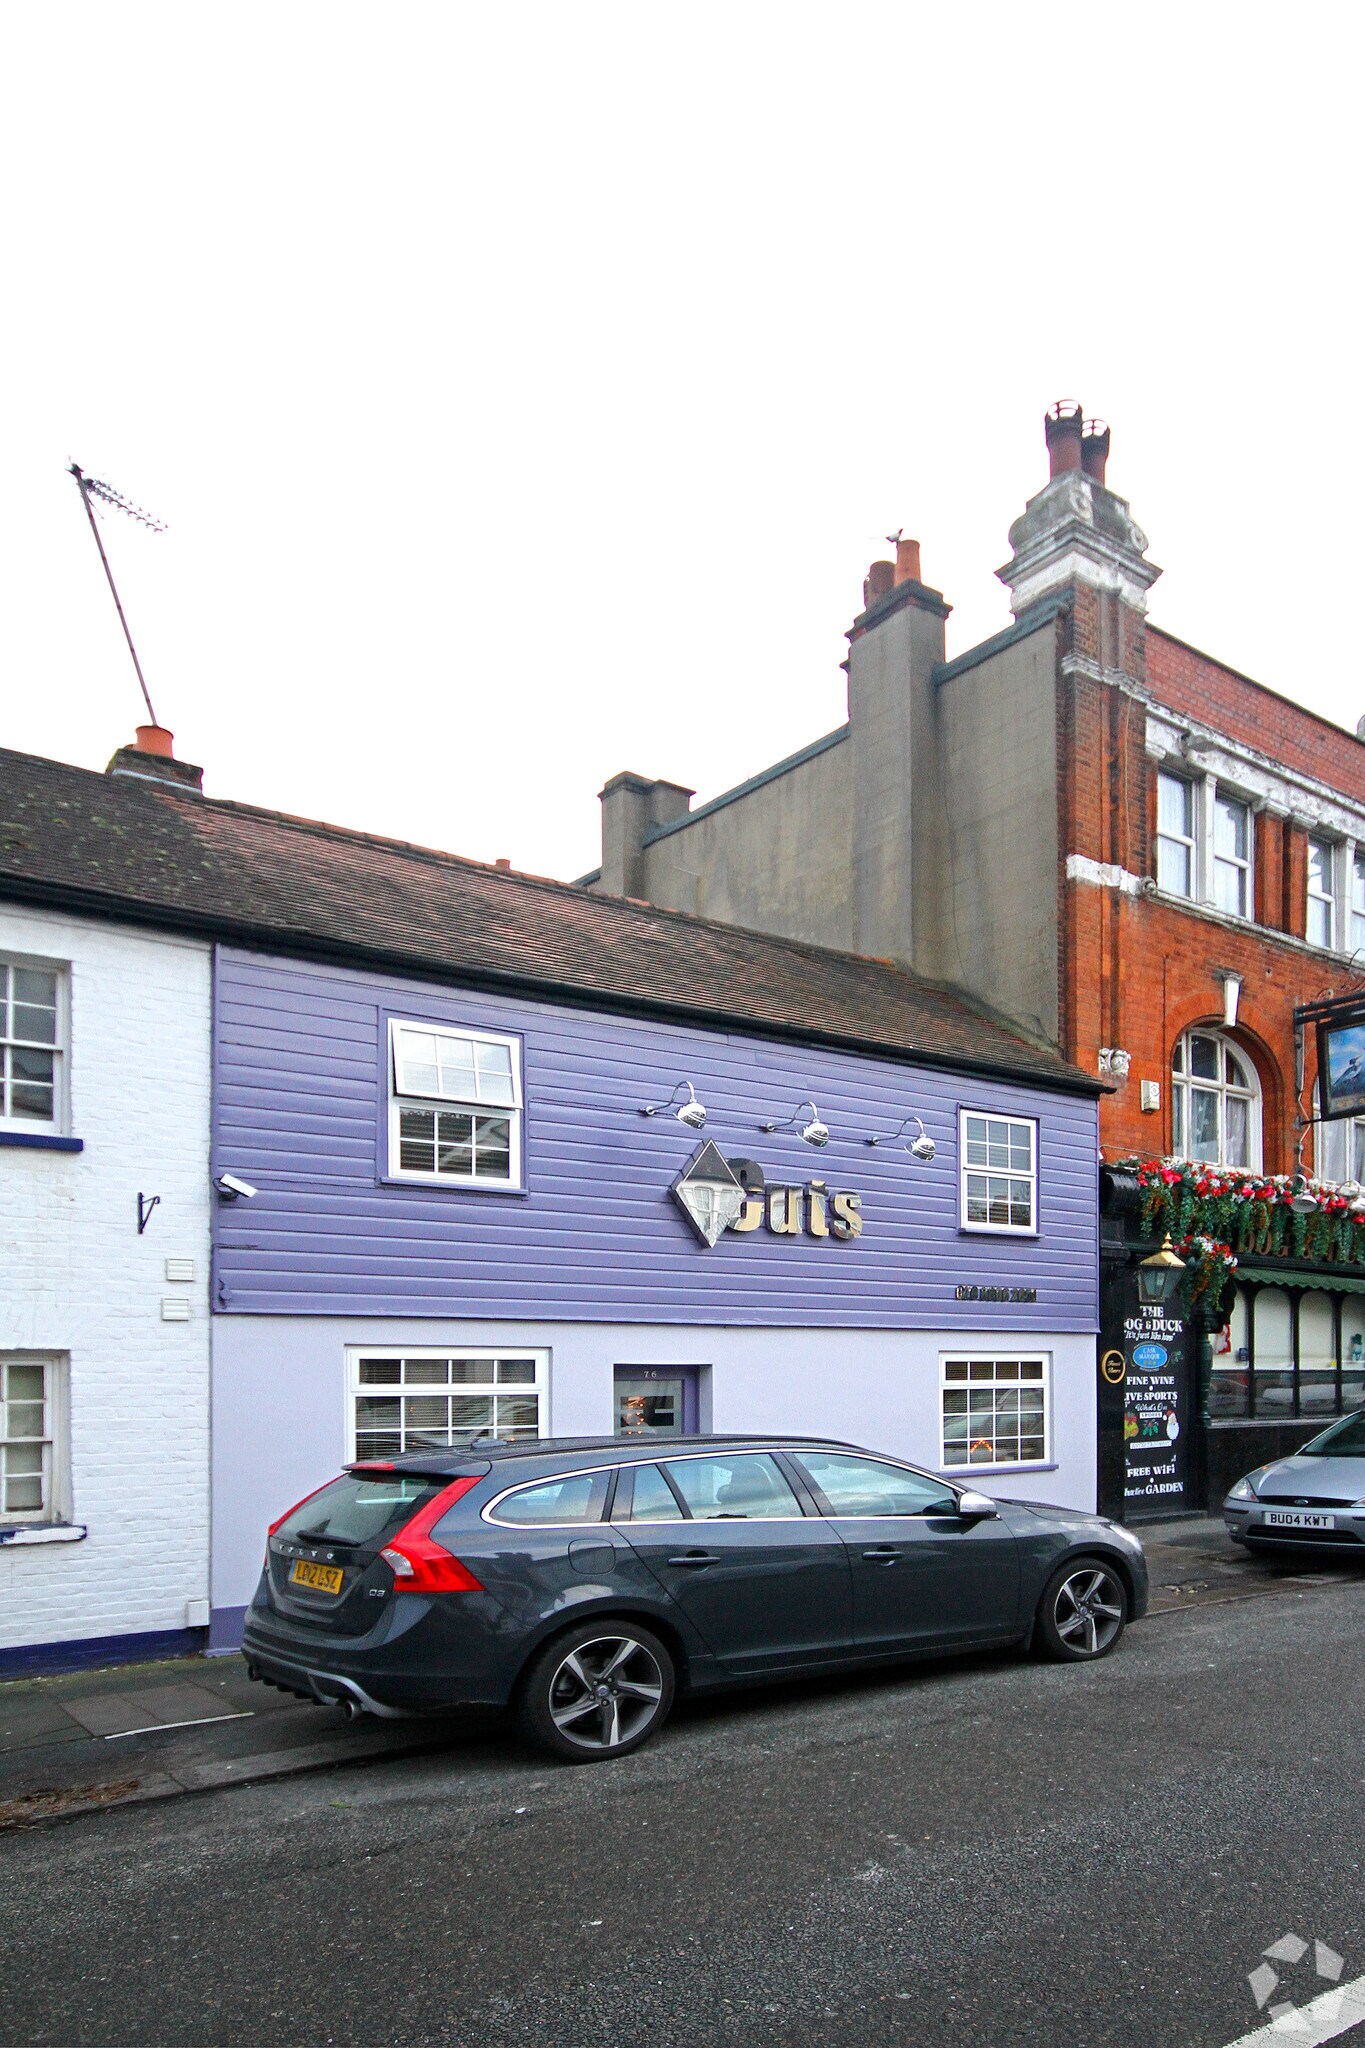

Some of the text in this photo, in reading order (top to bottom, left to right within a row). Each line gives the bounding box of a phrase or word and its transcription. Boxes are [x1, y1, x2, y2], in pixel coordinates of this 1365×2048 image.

[727, 1157, 863, 1241] Cuts
[1140, 1306, 1164, 1318] THE
[1145, 1320, 1152, 1330] &
[1152, 1319, 1183, 1332] DUCK
[1126, 1376, 1175, 1385] FINE WINE
[1144, 1391, 1178, 1401] SPORTS
[1127, 1467, 1151, 1478] FREE
[1145, 1482, 1184, 1495] GARDEN
[1270, 1513, 1329, 1527] BU04 KWT
